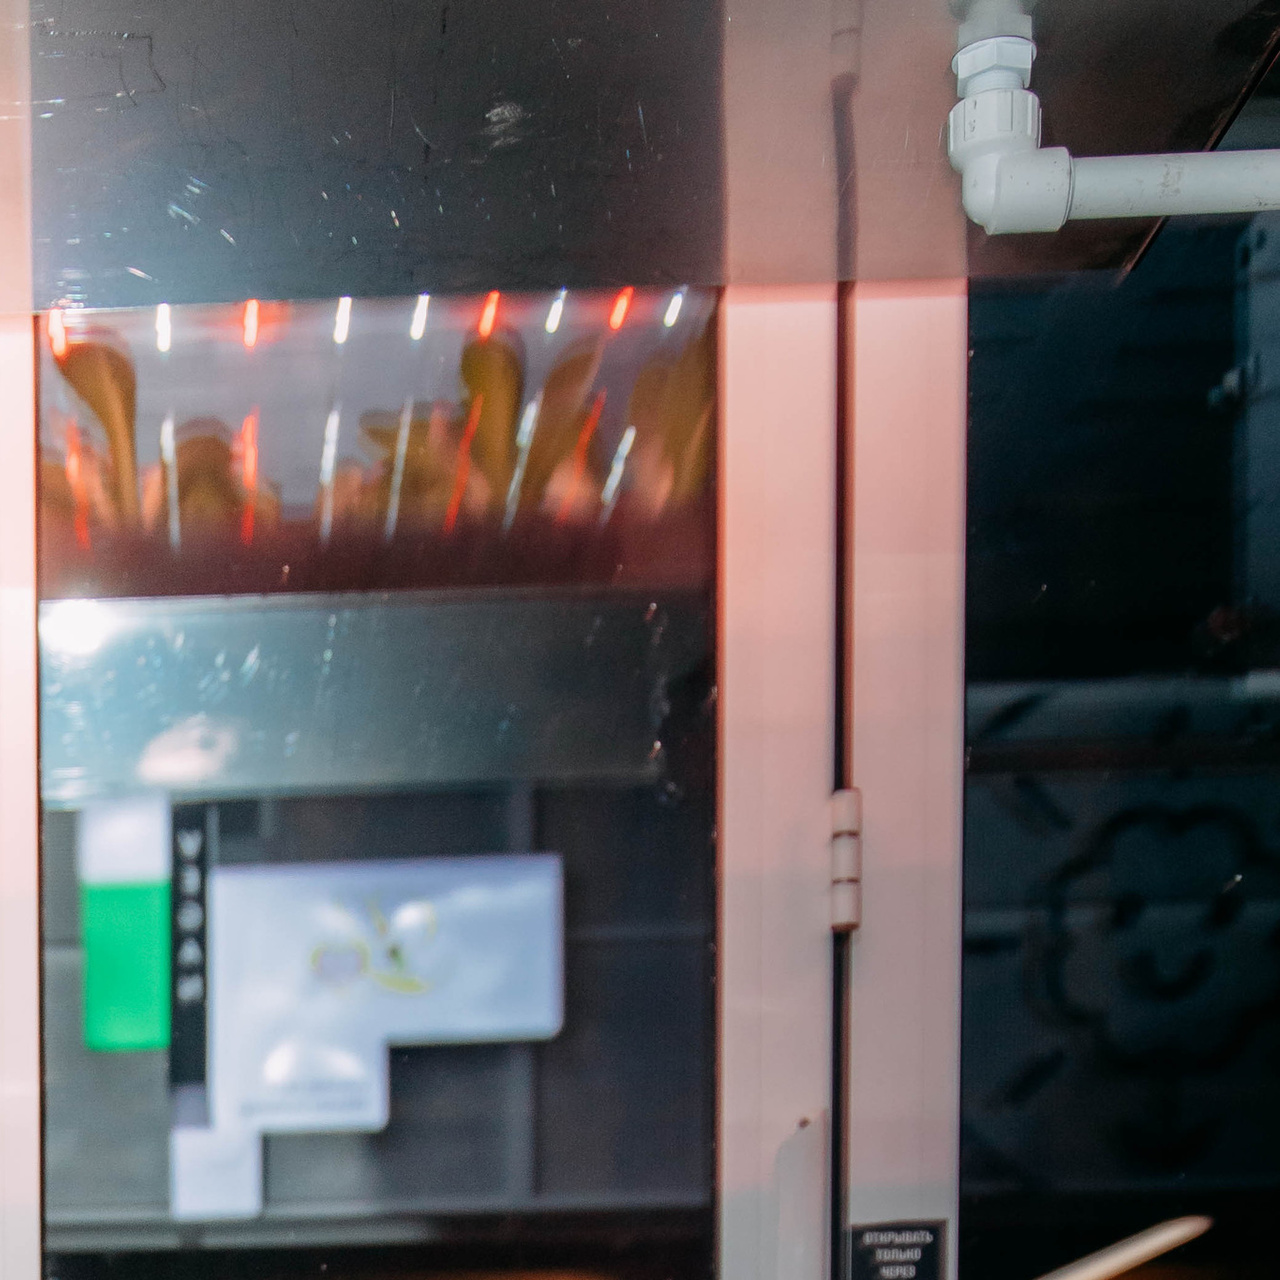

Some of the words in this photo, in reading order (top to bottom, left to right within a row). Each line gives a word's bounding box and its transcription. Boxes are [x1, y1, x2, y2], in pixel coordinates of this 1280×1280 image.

[863, 1230, 934, 1246] ОТКРЫВАТЬ
[875, 1248, 922, 1262] ТОЛЬКО
[879, 1264, 916, 1279] ЧЕРЕЗ
